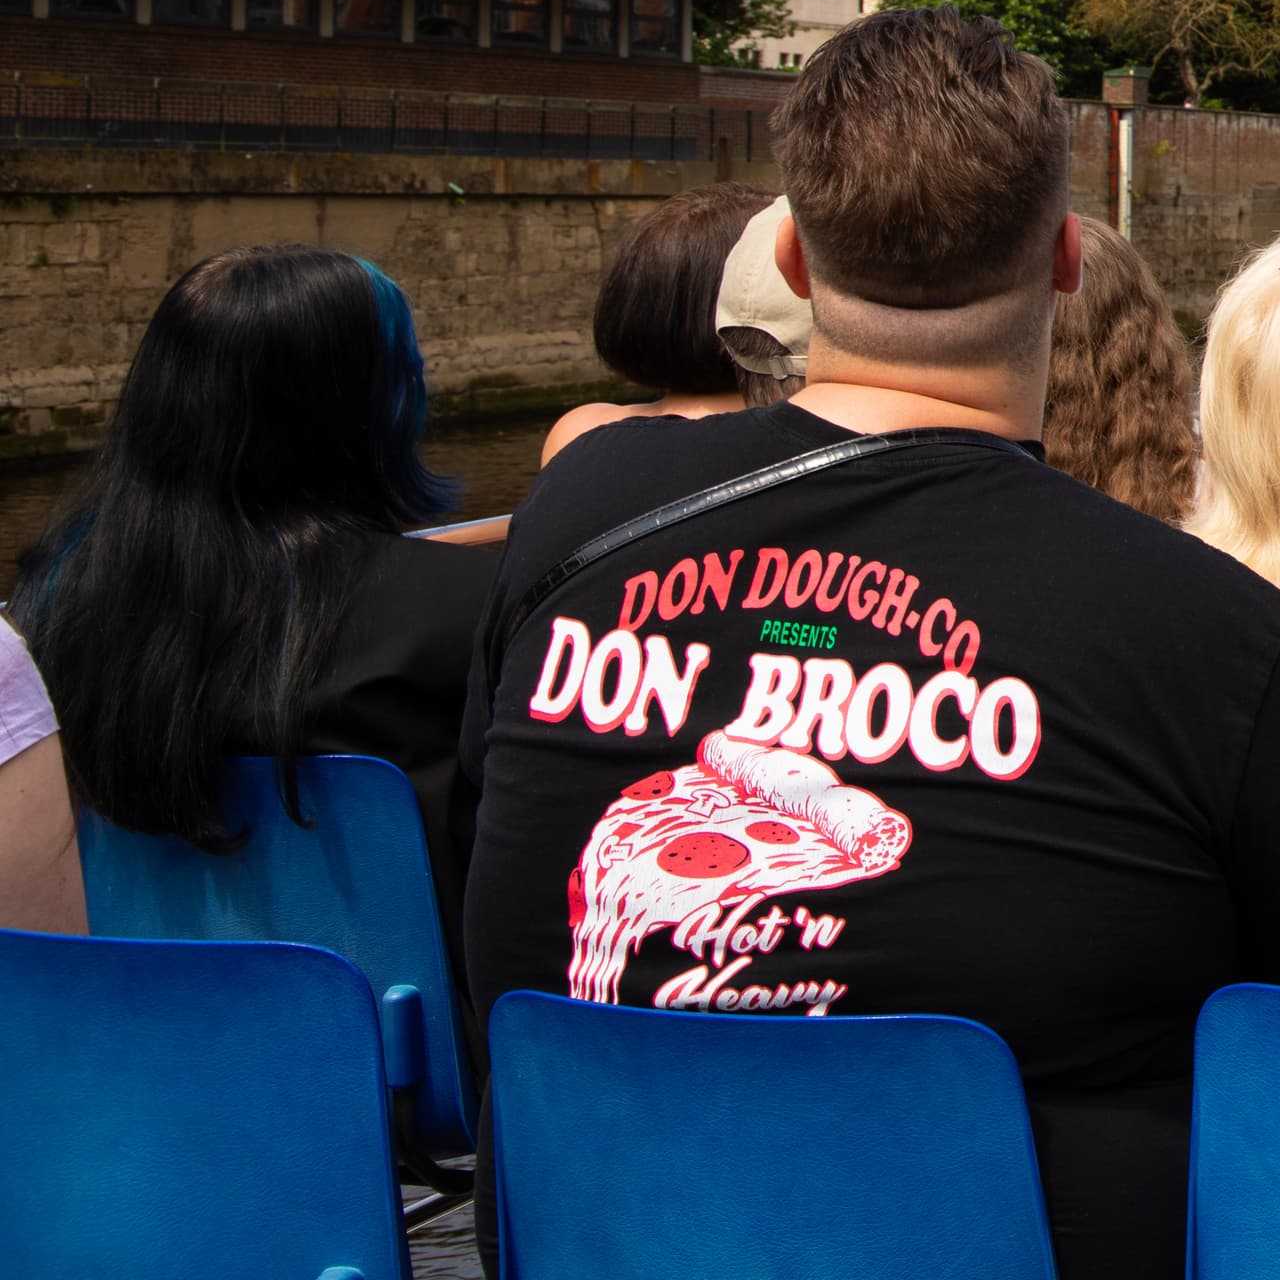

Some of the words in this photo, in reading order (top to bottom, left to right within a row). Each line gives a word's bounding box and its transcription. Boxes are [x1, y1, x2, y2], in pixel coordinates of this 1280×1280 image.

[618, 548, 744, 630] DON
[759, 619, 838, 650] PRESENTS
[529, 616, 711, 737] DON
[724, 652, 1042, 781] BROCO
[671, 891, 791, 968] Hot
[651, 955, 848, 1017] Heavy
